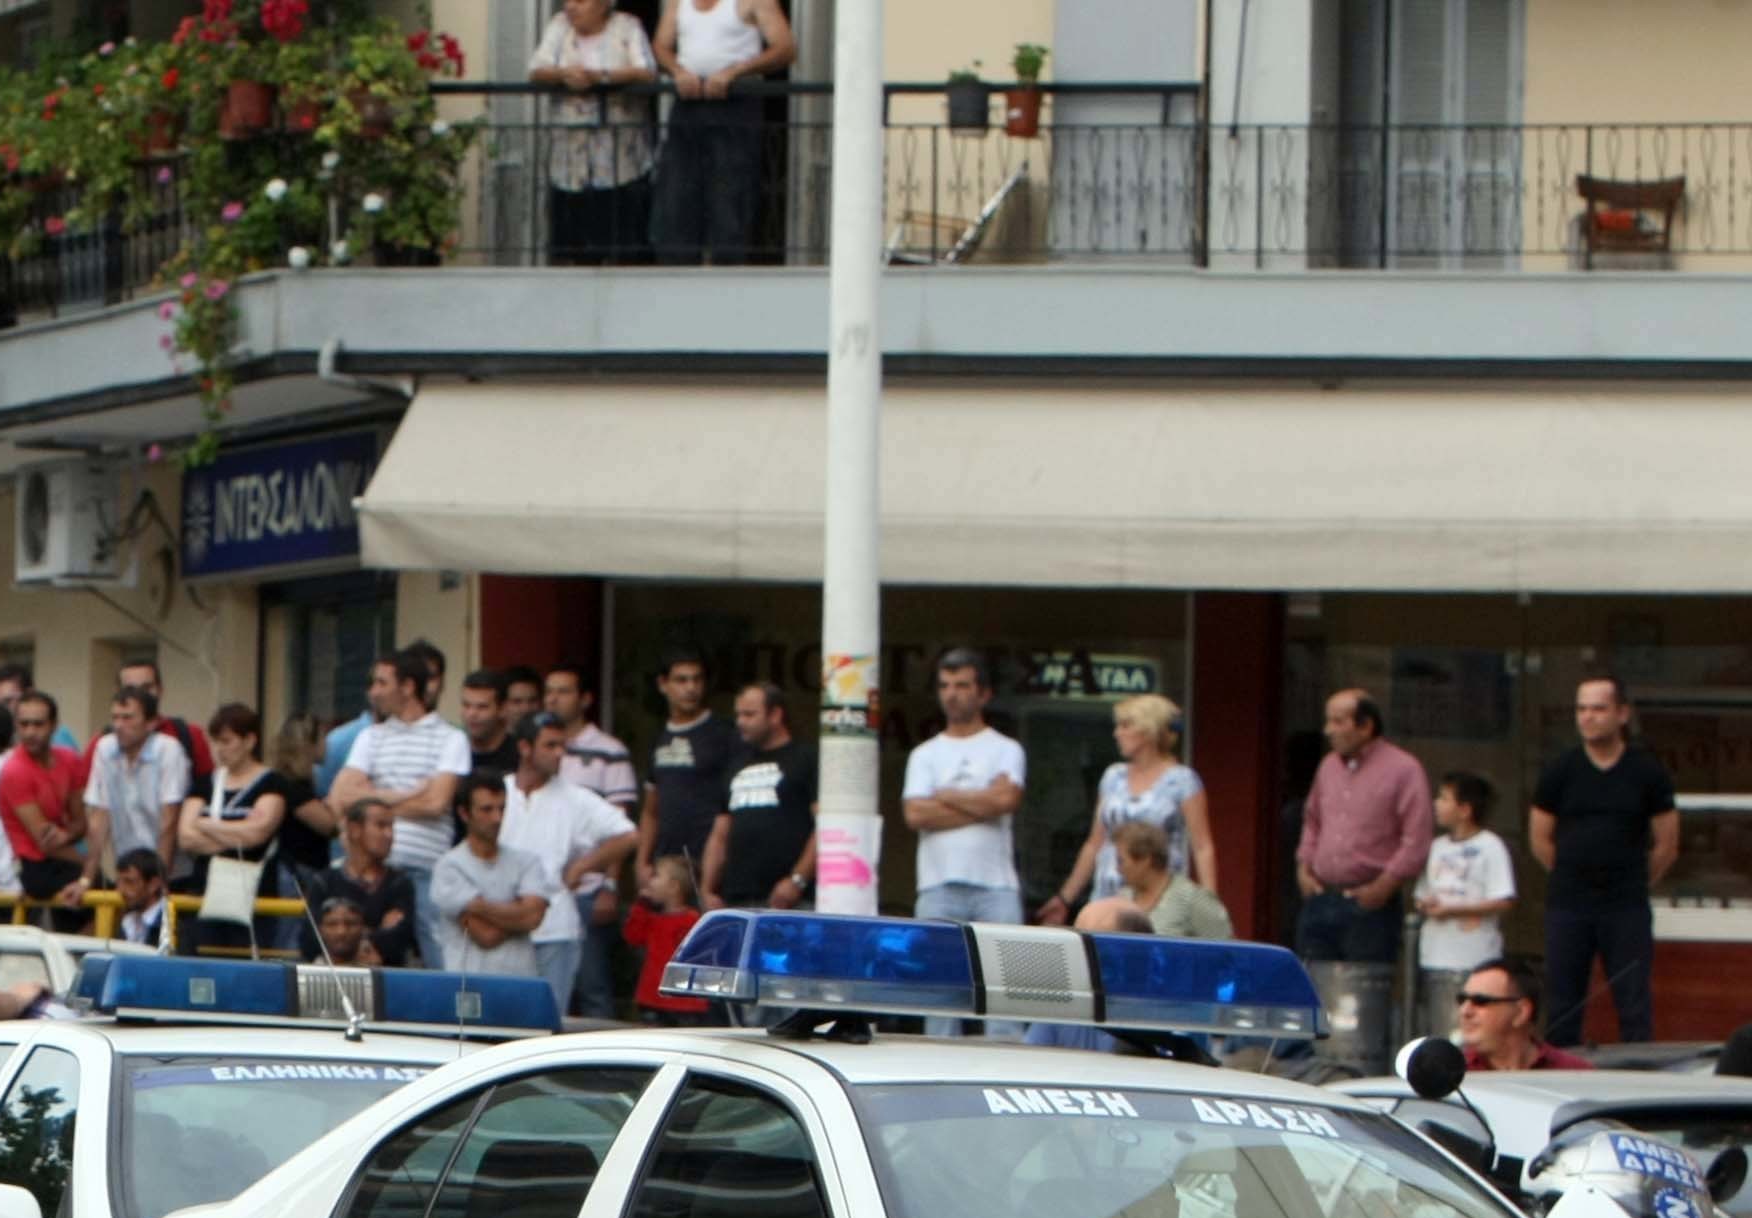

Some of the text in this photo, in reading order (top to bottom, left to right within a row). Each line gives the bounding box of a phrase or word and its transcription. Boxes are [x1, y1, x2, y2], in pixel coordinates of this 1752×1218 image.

[211, 1064, 378, 1081] ΕΛΛΗΝΙΚΗ
[984, 1087, 1342, 1140] ΑΜΕΣΗ ΔΡΑΣΗ
